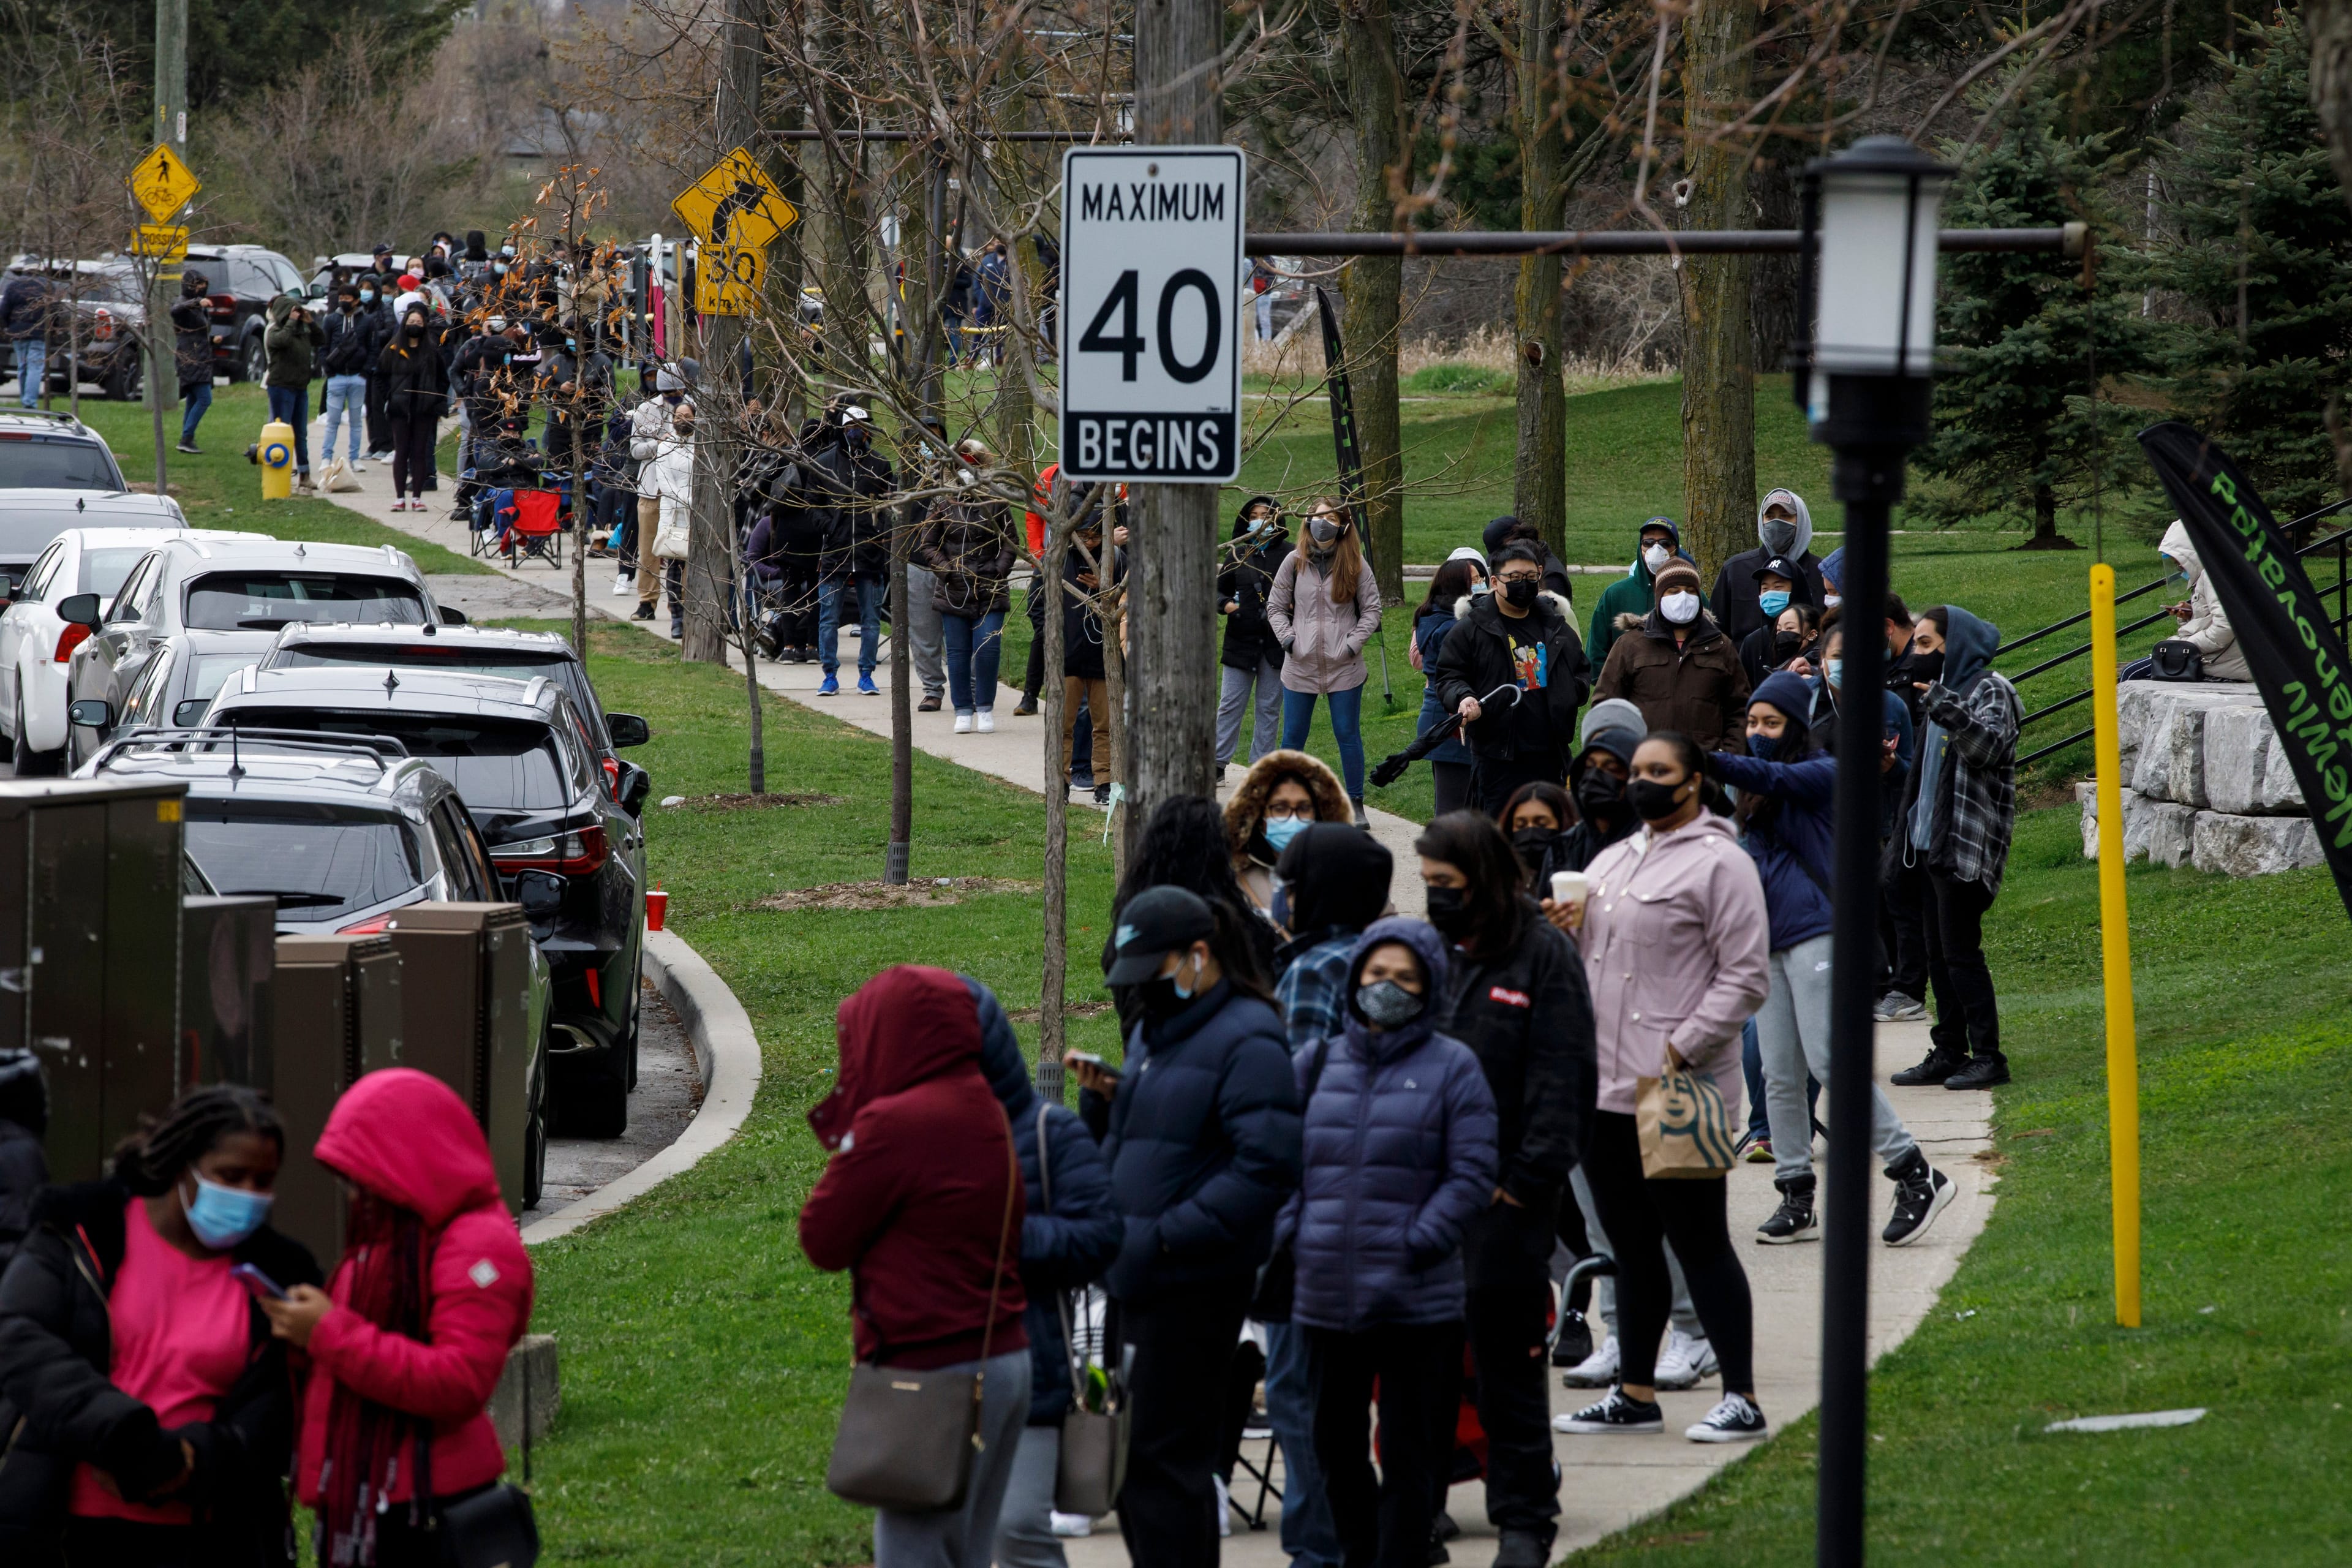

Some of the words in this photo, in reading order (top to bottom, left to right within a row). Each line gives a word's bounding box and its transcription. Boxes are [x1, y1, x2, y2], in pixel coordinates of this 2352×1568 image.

[1082, 183, 1224, 221] MAXIMUM
[1079, 268, 1221, 384] 40
[1079, 420, 1219, 470] BEGINS
